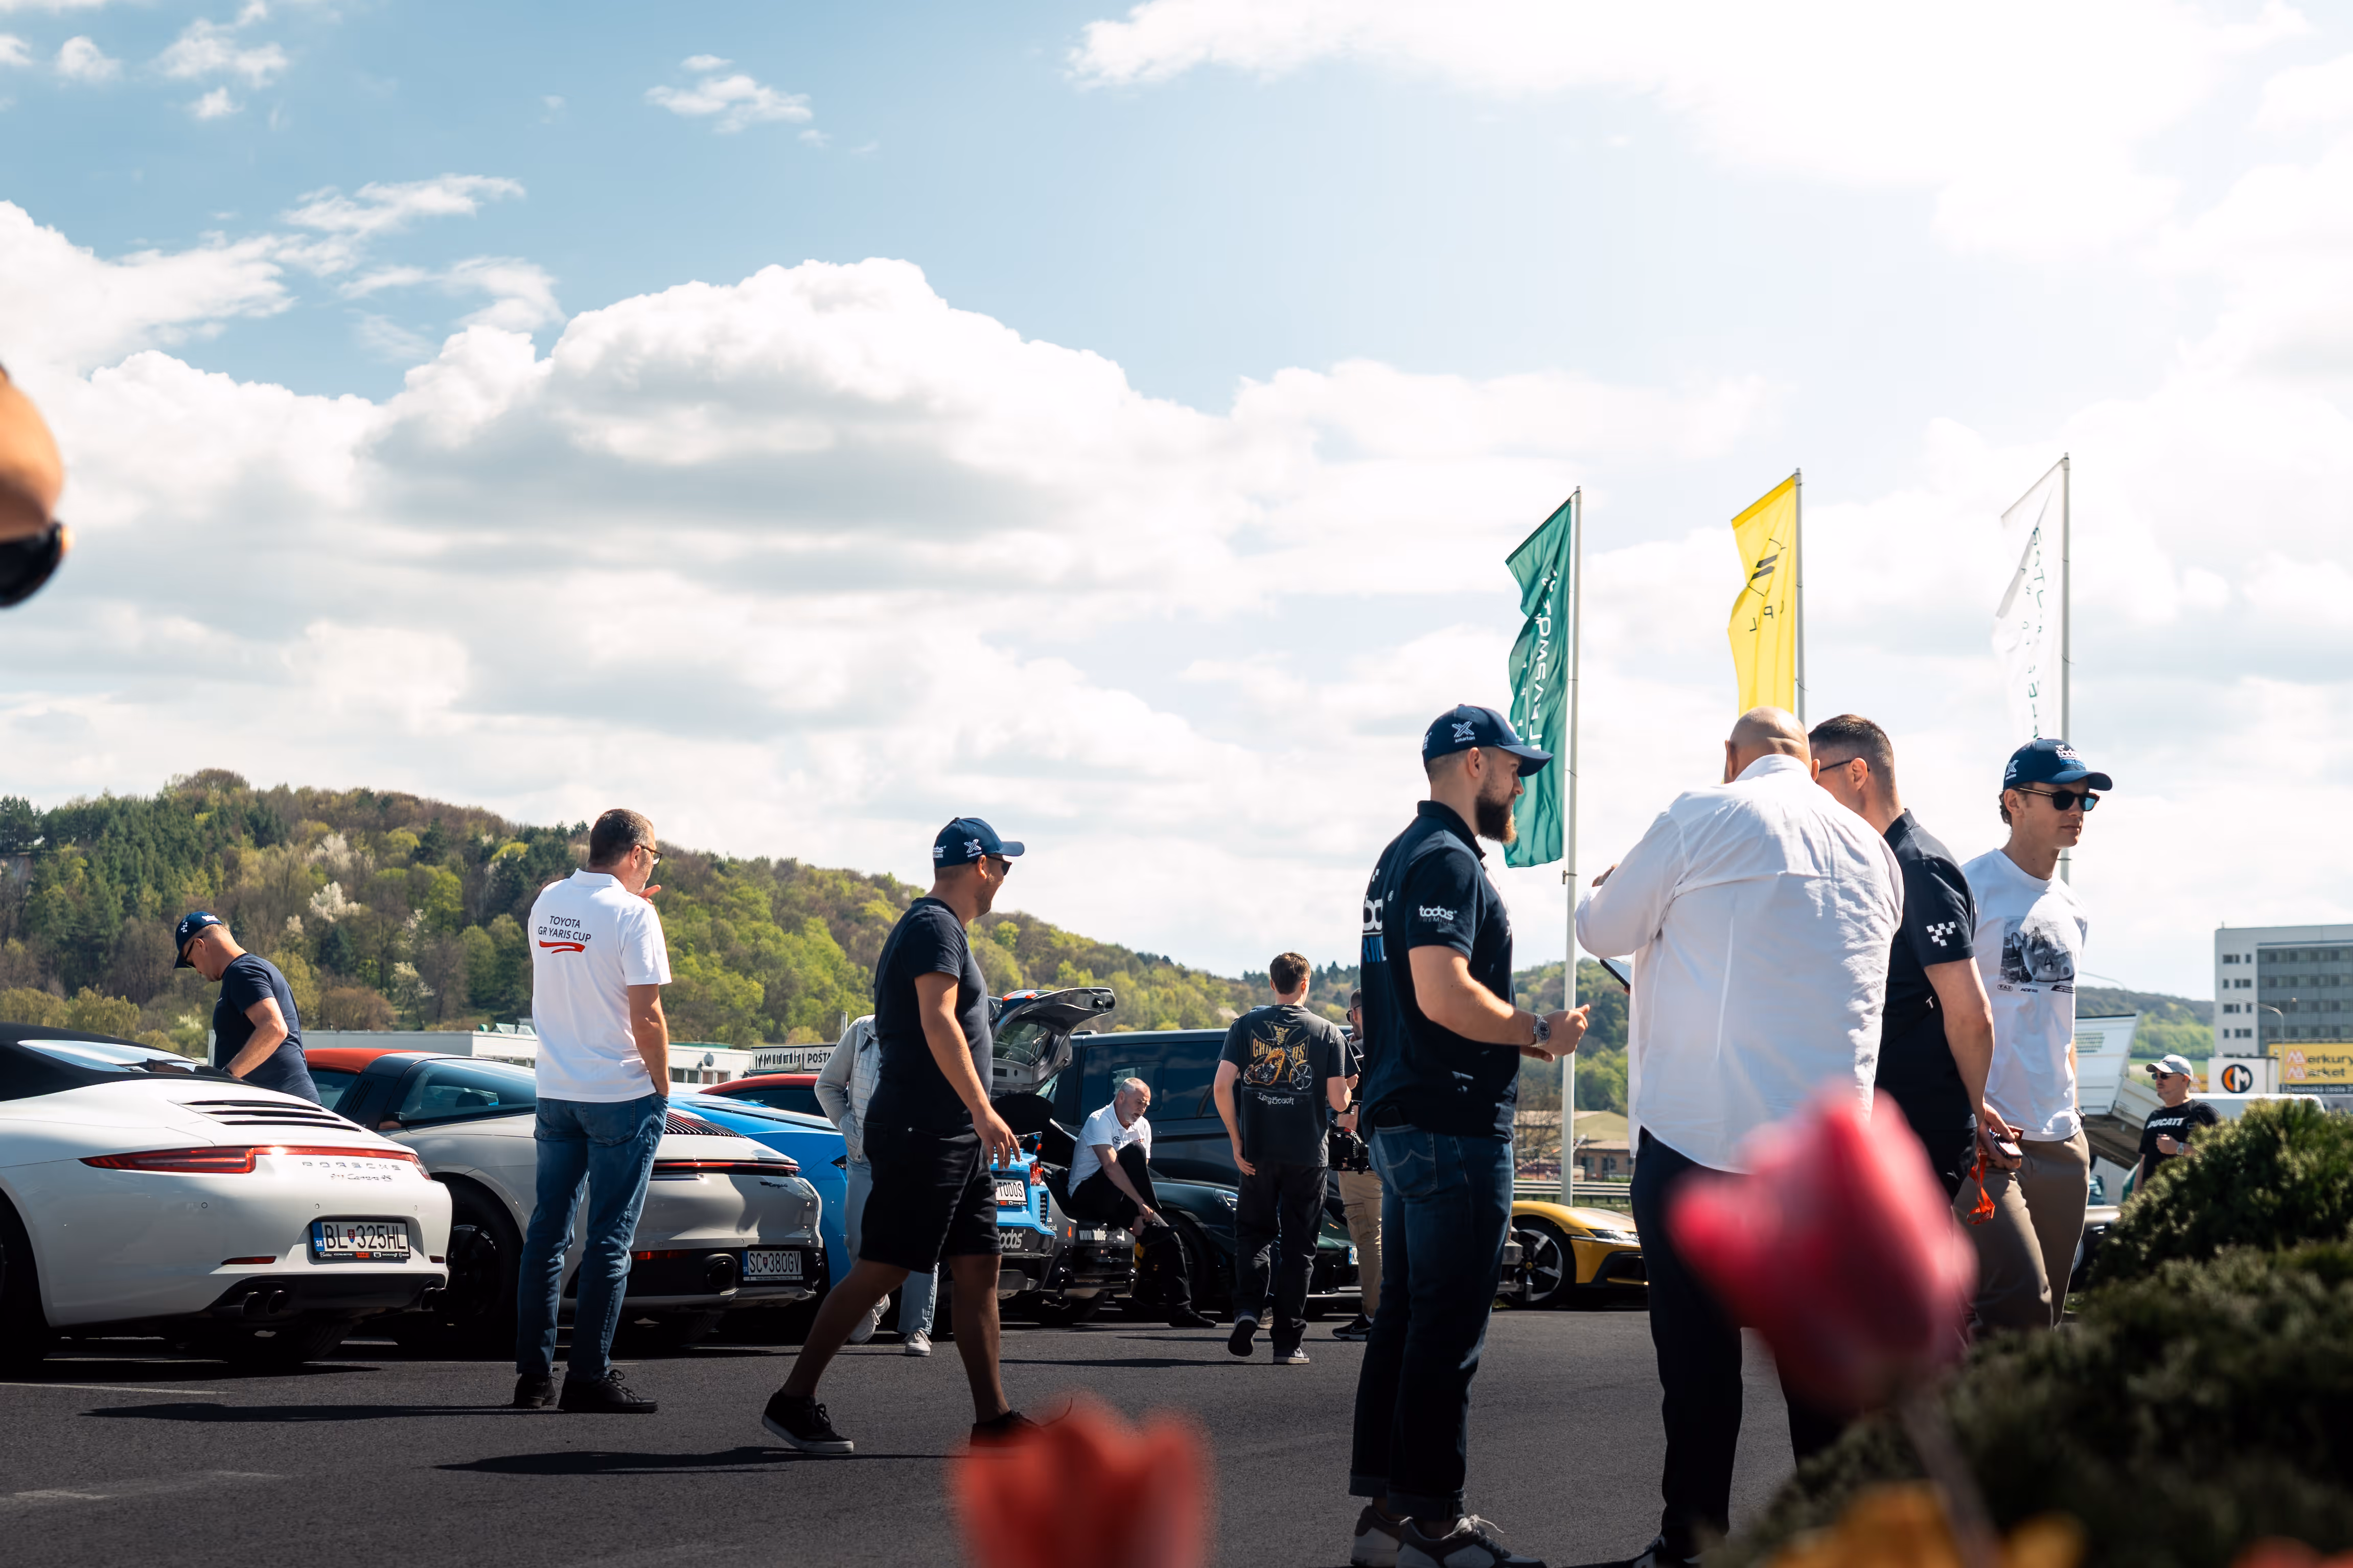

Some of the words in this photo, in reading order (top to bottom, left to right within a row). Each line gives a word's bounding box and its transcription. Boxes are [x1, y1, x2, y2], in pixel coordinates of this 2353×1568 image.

[1419, 905, 1454, 921] todos
[549, 916, 580, 928] TOYOTA
[538, 926, 547, 935] GR
[549, 928, 571, 939] YARIS
[573, 931, 591, 942] CUP
[2147, 1118, 2184, 1129] DUCATI
[998, 1182, 1023, 1197] TODOS
[325, 1224, 348, 1249] BL
[356, 1225, 406, 1249] 325HL
[749, 1252, 763, 1273] SC
[769, 1252, 799, 1273] 380GV
